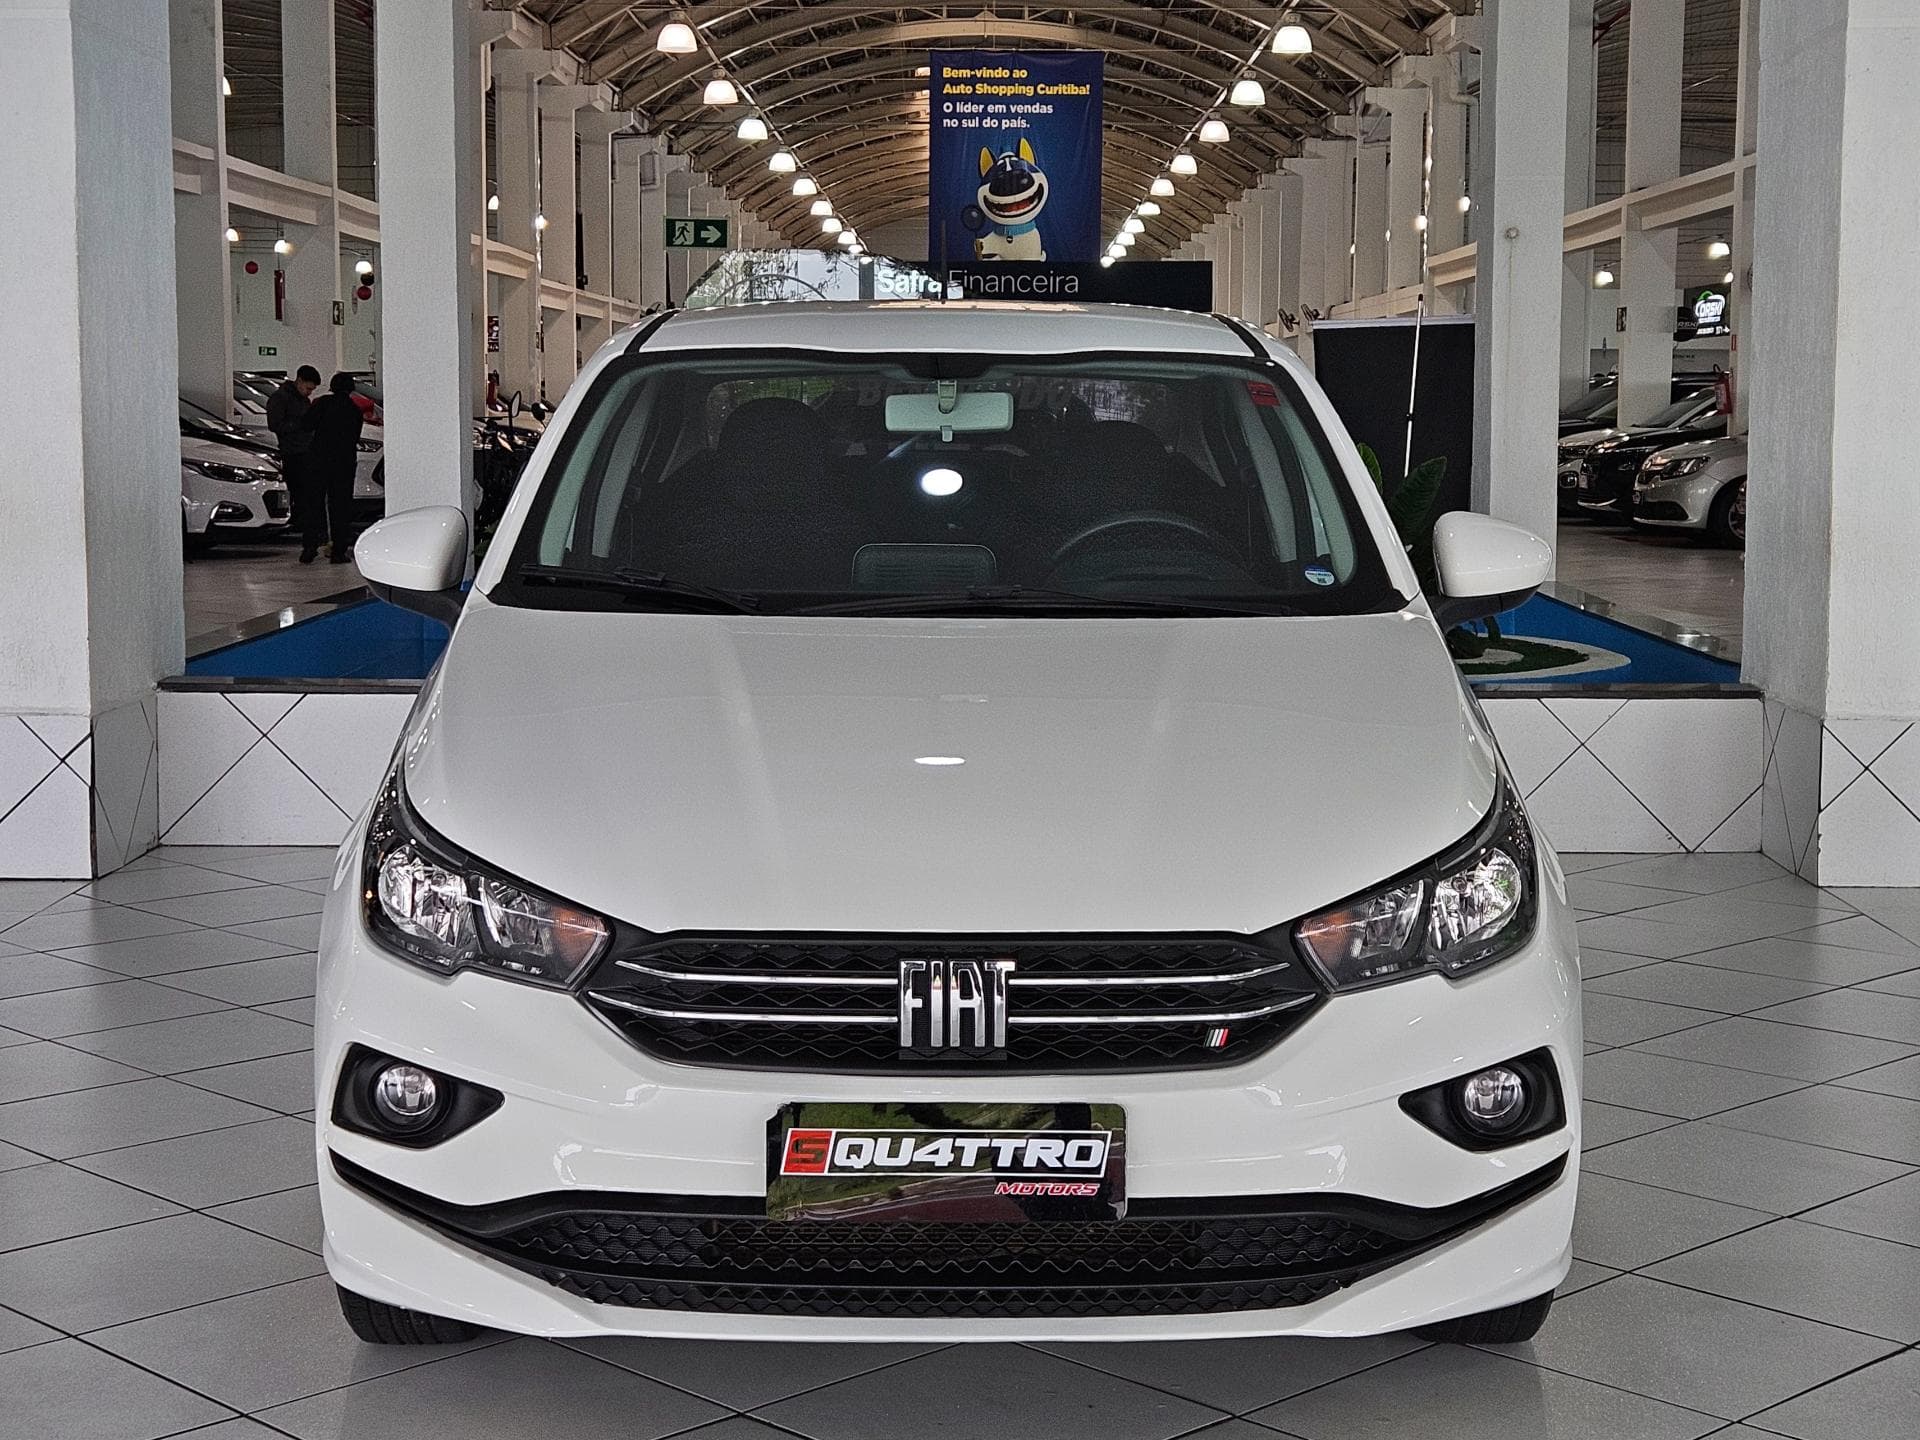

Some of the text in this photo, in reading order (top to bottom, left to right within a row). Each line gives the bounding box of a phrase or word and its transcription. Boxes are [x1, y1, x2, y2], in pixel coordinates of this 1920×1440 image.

[943, 67, 1028, 78] Bem-vindo ao
[943, 83, 1091, 96] Auto Shopping Curitiba!
[943, 102, 1054, 114] O líder em vendas
[943, 116, 1030, 130] no sul do país.
[877, 269, 1079, 293] Safra Financeira
[901, 961, 1015, 1048] FIAT
[994, 1182, 1101, 1196] MOTORS
